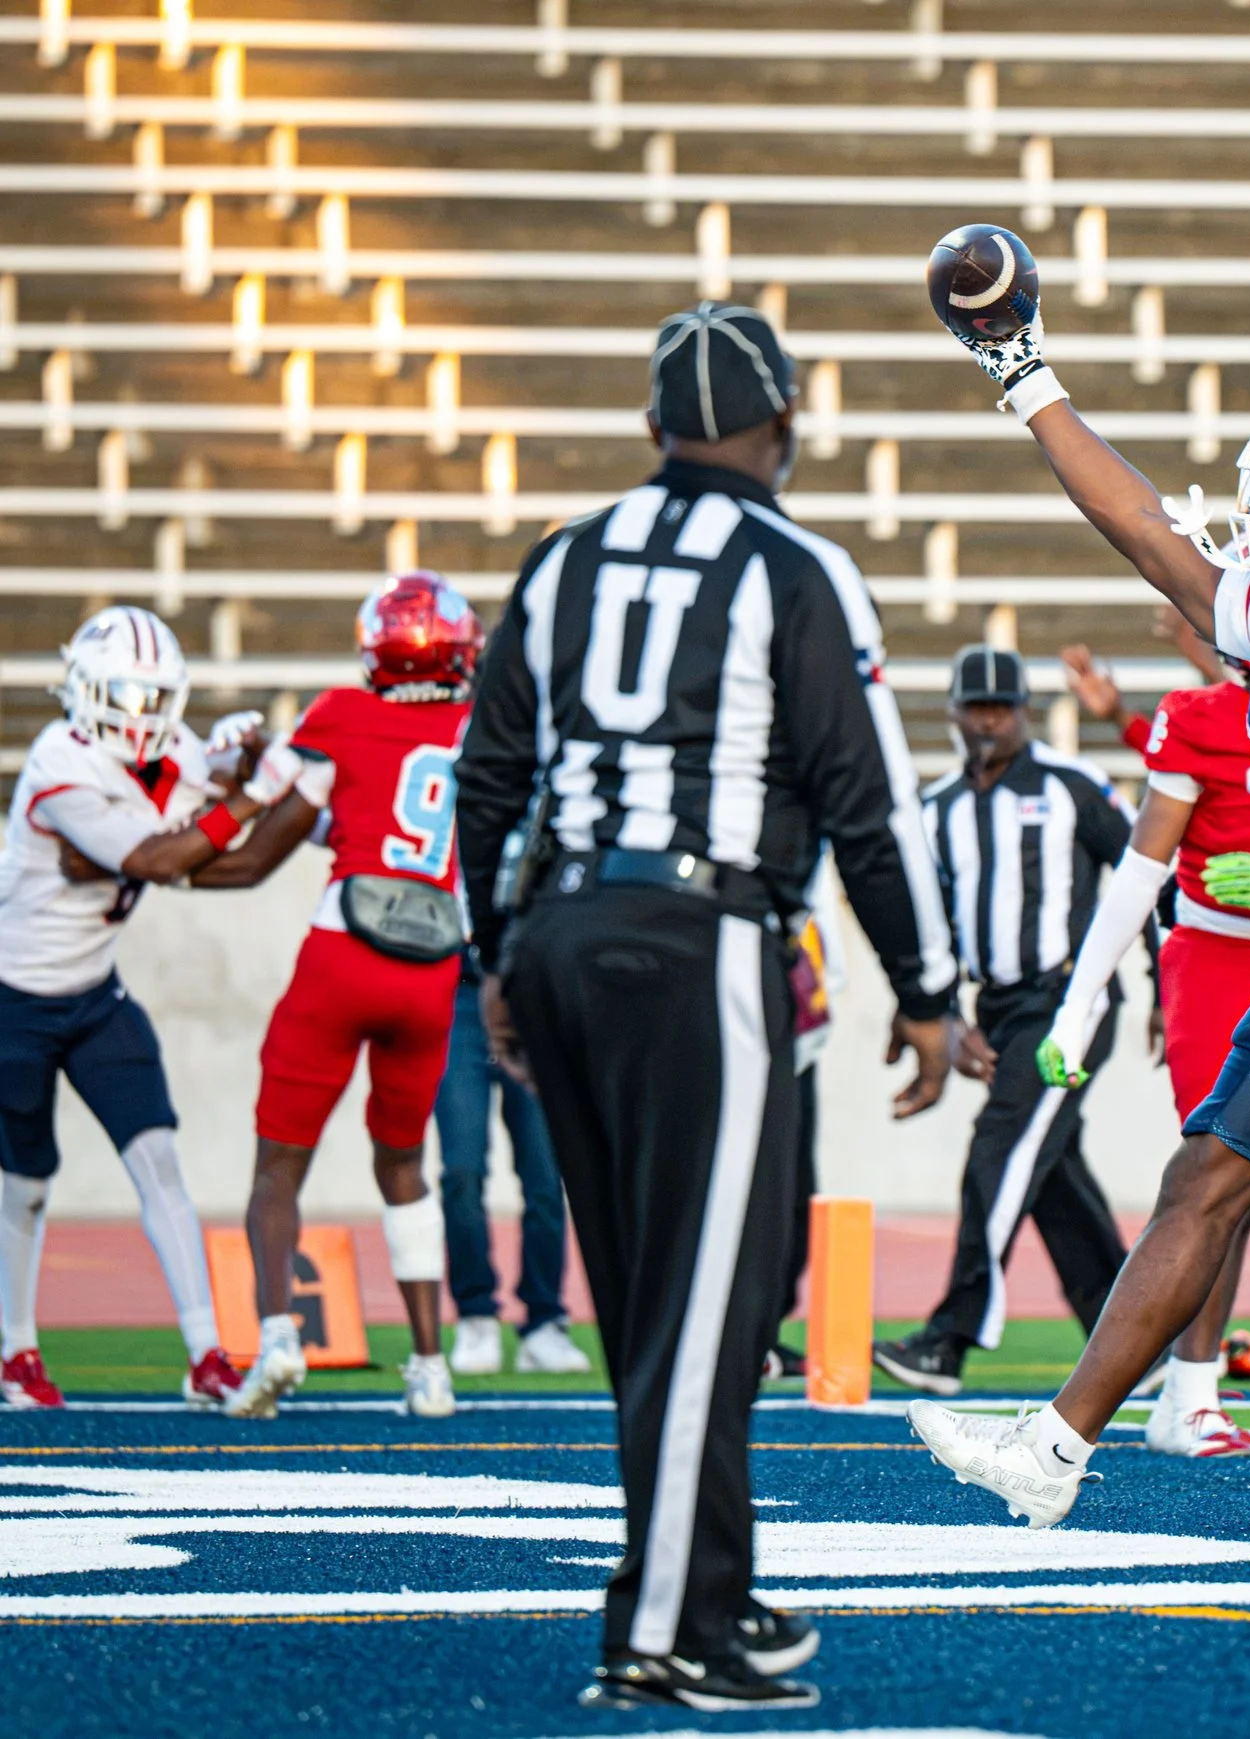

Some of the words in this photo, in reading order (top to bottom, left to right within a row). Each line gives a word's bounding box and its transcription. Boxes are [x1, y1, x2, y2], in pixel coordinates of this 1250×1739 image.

[581, 562, 703, 734] U
[381, 743, 463, 881] 9
[964, 1456, 1064, 1501] BATTLE
